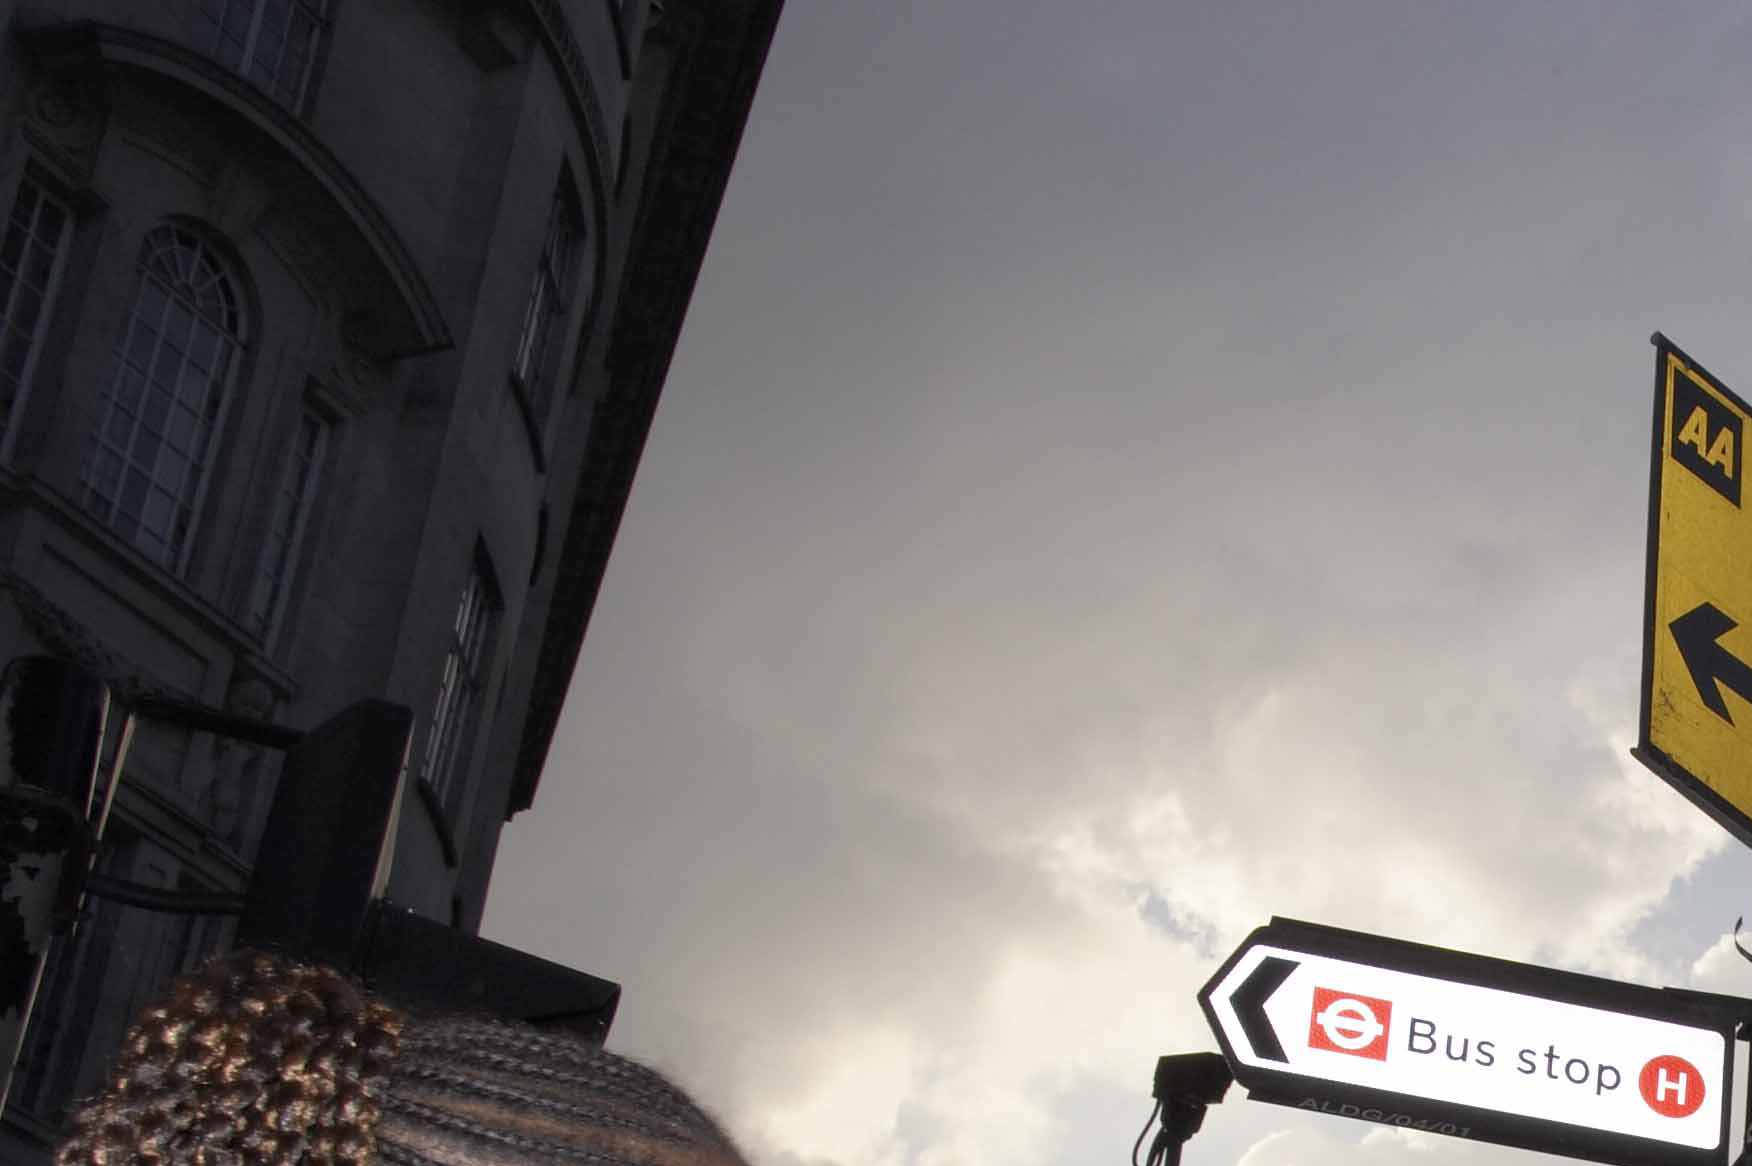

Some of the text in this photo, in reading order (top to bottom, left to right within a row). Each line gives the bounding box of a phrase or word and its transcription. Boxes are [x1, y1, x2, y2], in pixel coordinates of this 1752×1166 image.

[1678, 405, 1735, 479] AA
[1407, 1017, 1688, 1105] Bus stop H
